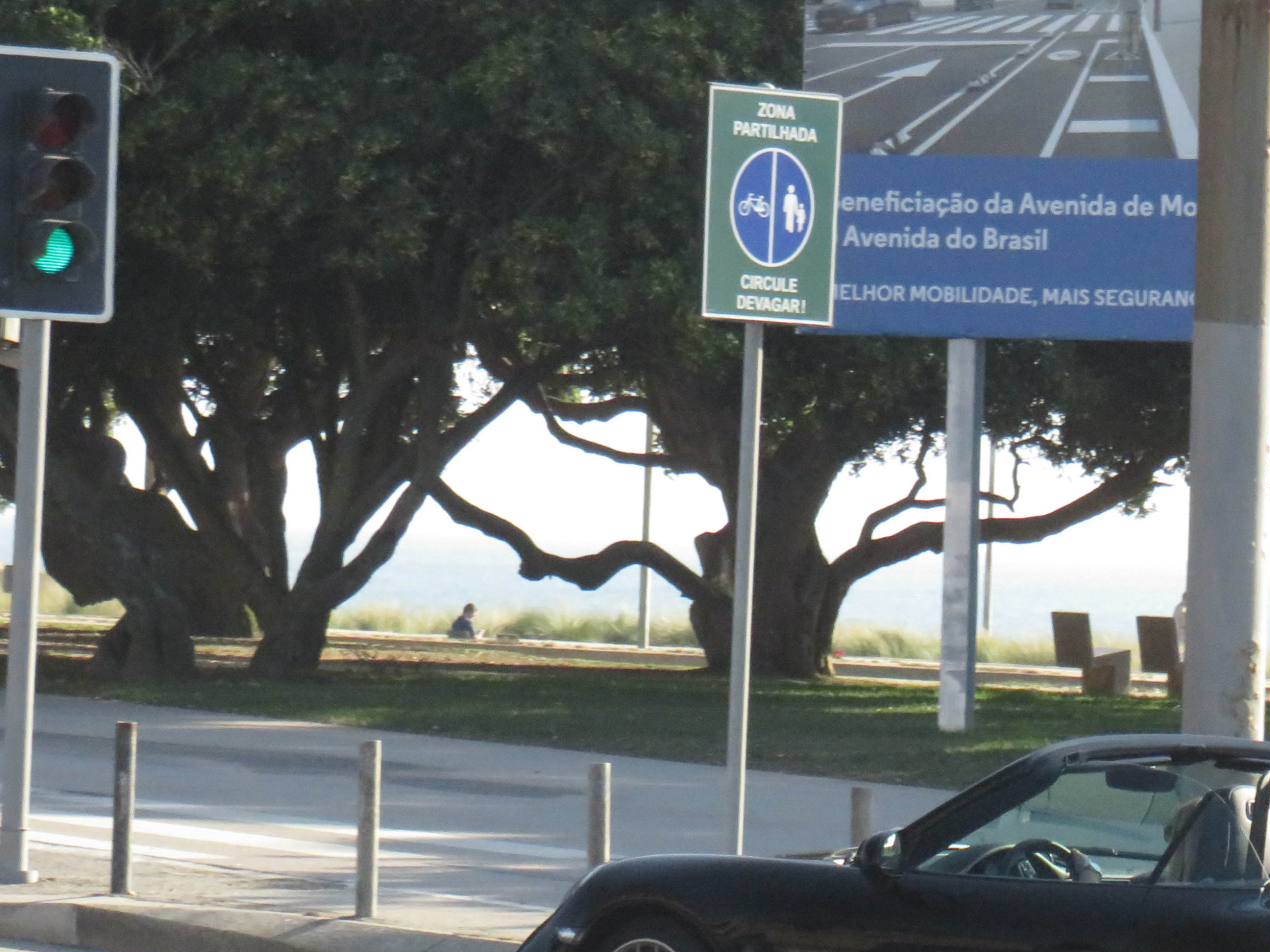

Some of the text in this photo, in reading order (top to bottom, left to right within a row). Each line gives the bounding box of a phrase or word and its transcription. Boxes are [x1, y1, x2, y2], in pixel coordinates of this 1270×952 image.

[757, 102, 796, 120] ZONA
[733, 121, 818, 143] PARTILHADA
[837, 190, 978, 218] eneficiação
[984, 192, 1014, 215] da
[1018, 192, 1118, 217] Avenida
[1123, 194, 1154, 217] de
[843, 225, 1048, 251] Avenida do Brasil
[740, 274, 798, 293] CIRCULE
[736, 295, 807, 314] DEVAGAR!
[910, 285, 1038, 307] MOBILIDADE,
[1042, 288, 1090, 306] MAIS
